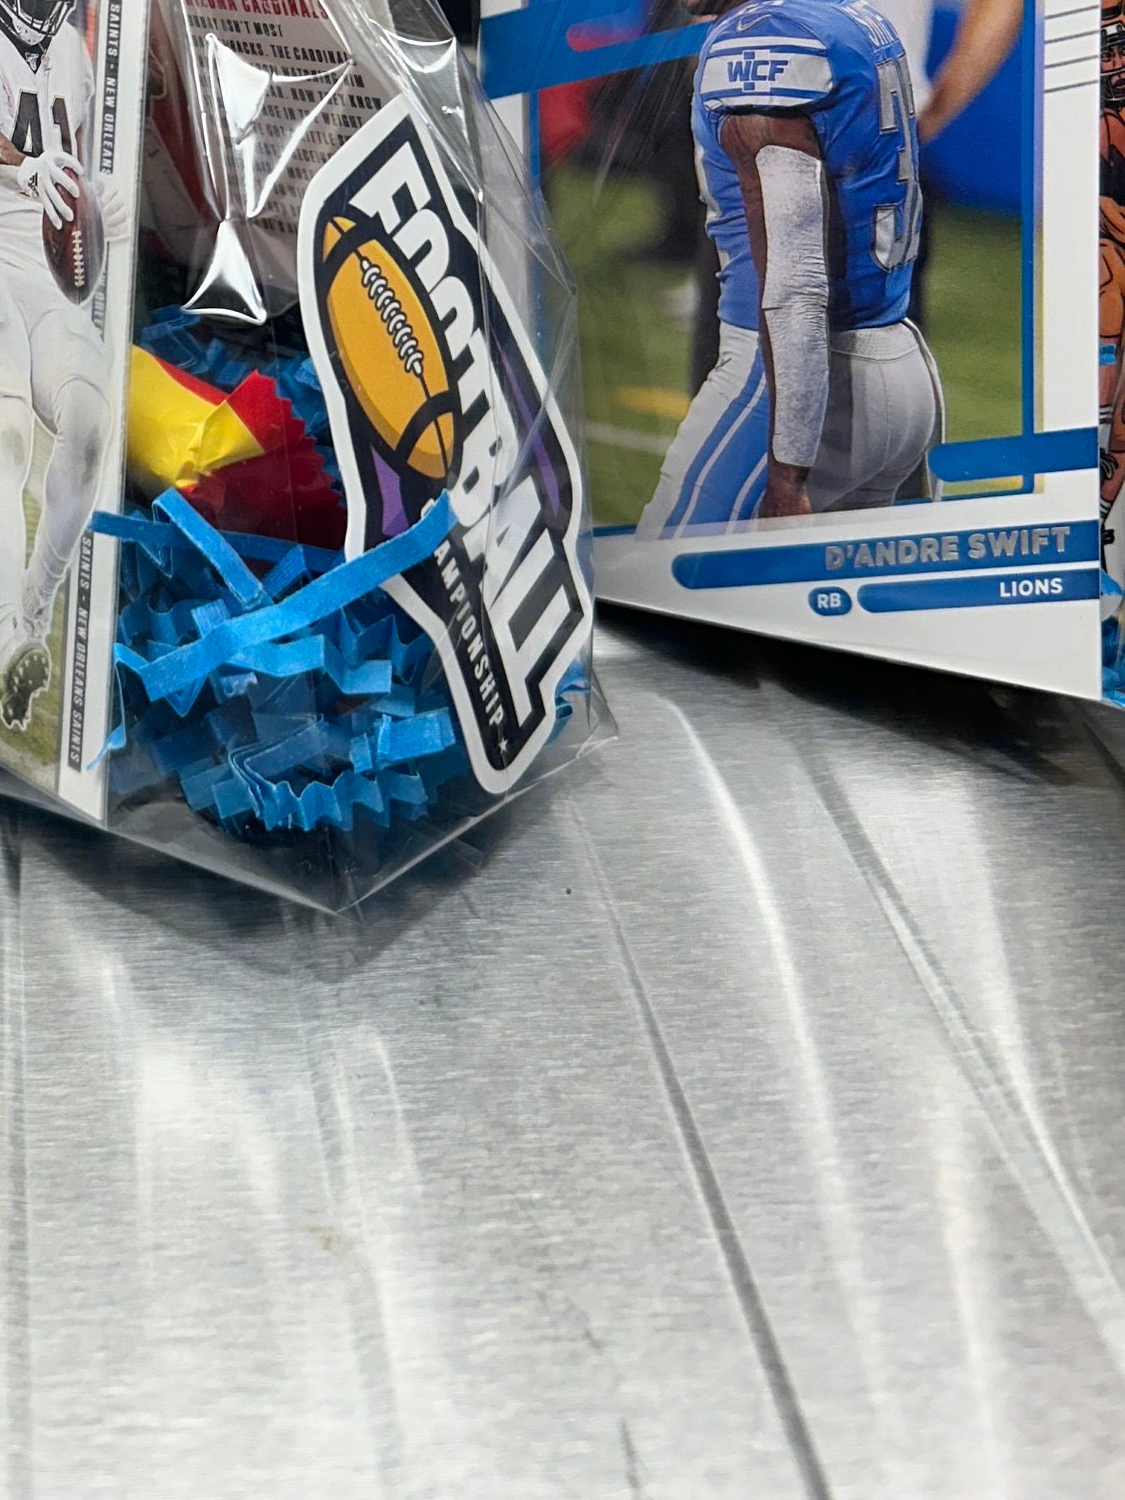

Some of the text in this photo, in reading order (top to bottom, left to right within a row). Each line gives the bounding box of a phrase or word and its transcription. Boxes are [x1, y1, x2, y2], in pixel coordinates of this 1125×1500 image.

[107, 4, 121, 57] SAINTS
[270, 44, 292, 60] THE
[105, 77, 117, 108] NEW
[727, 59, 789, 83] WCF
[11, 88, 73, 158] 41
[101, 113, 114, 176] ORLEANS
[349, 141, 584, 728] FOOTBALL
[79, 536, 92, 589] SAINTS
[825, 526, 1071, 571] D'ANDRE SWIFT
[421, 498, 505, 728] AMPIONSHIP
[817, 593, 842, 609] RB
[999, 577, 1064, 598] LIONS
[77, 608, 89, 640] NEW
[73, 643, 87, 707] ORLEANS
[68, 711, 83, 764] SAINTS
